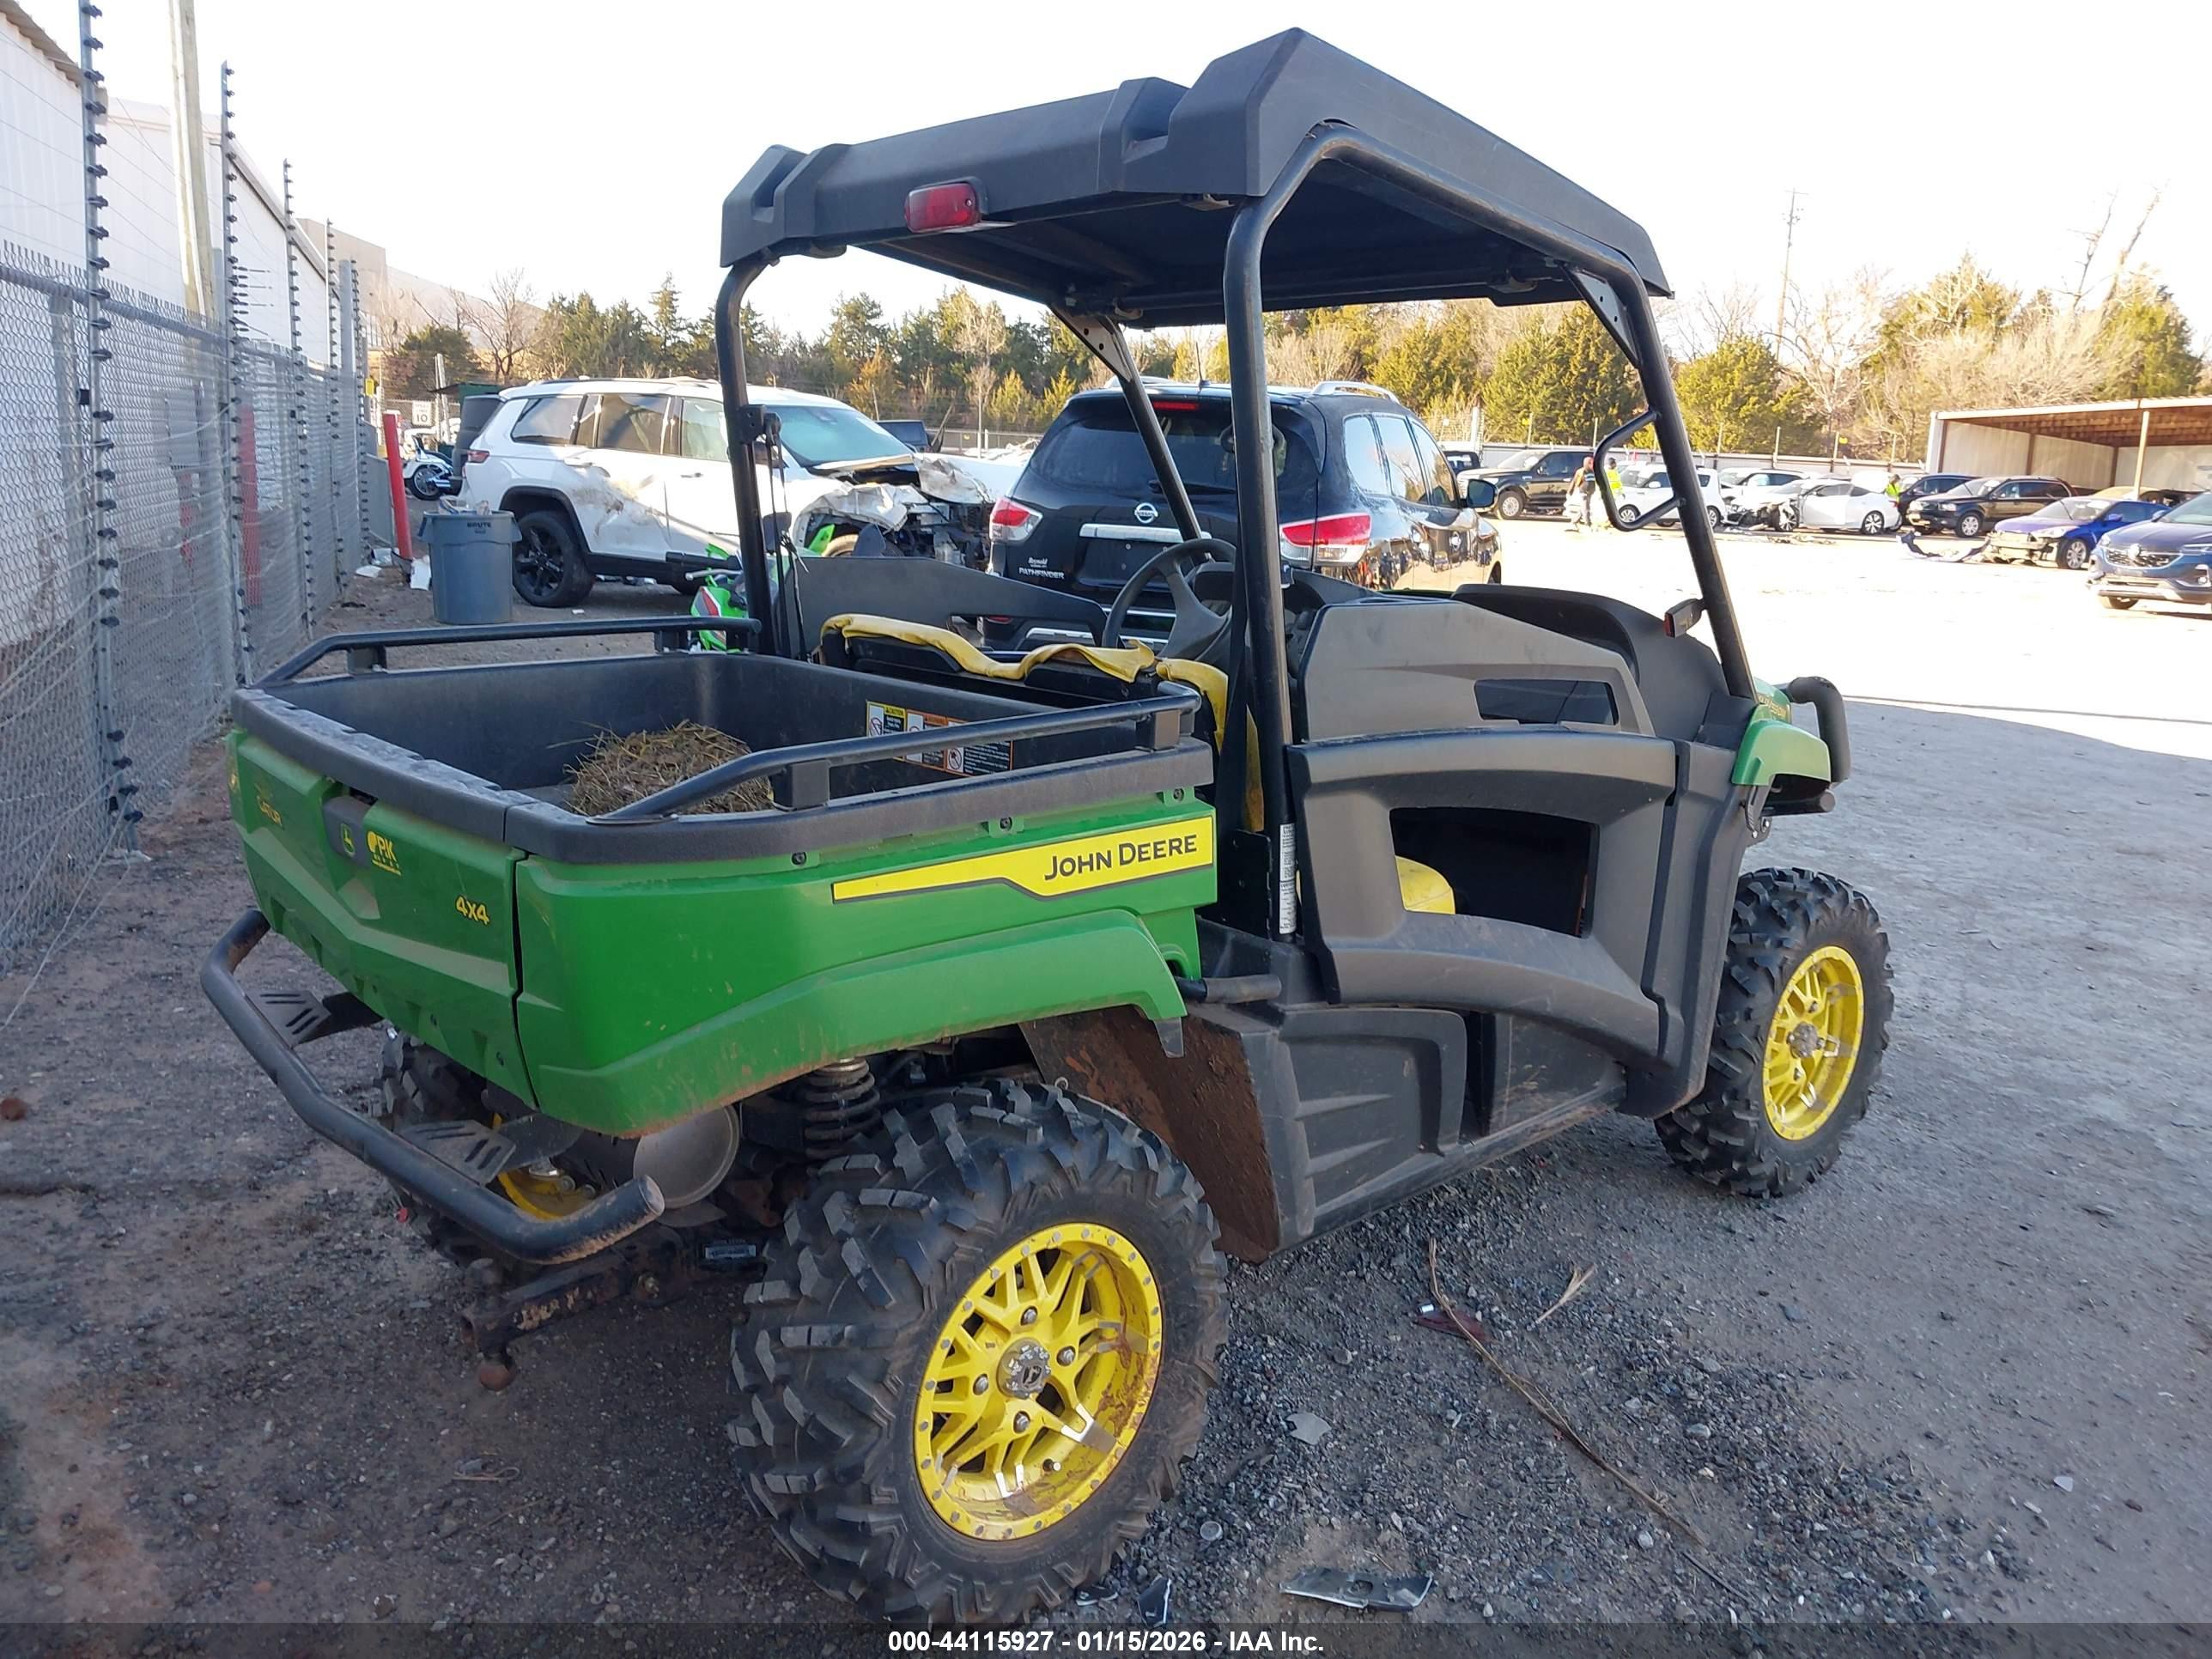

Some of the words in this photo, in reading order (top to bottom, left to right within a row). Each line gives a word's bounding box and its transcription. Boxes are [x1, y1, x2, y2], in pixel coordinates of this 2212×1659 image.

[416, 414, 428, 422] 10
[1018, 567, 1065, 580] PATHFINDER
[1045, 850, 1112, 881] JOHN
[1119, 835, 1198, 866] DEERE
